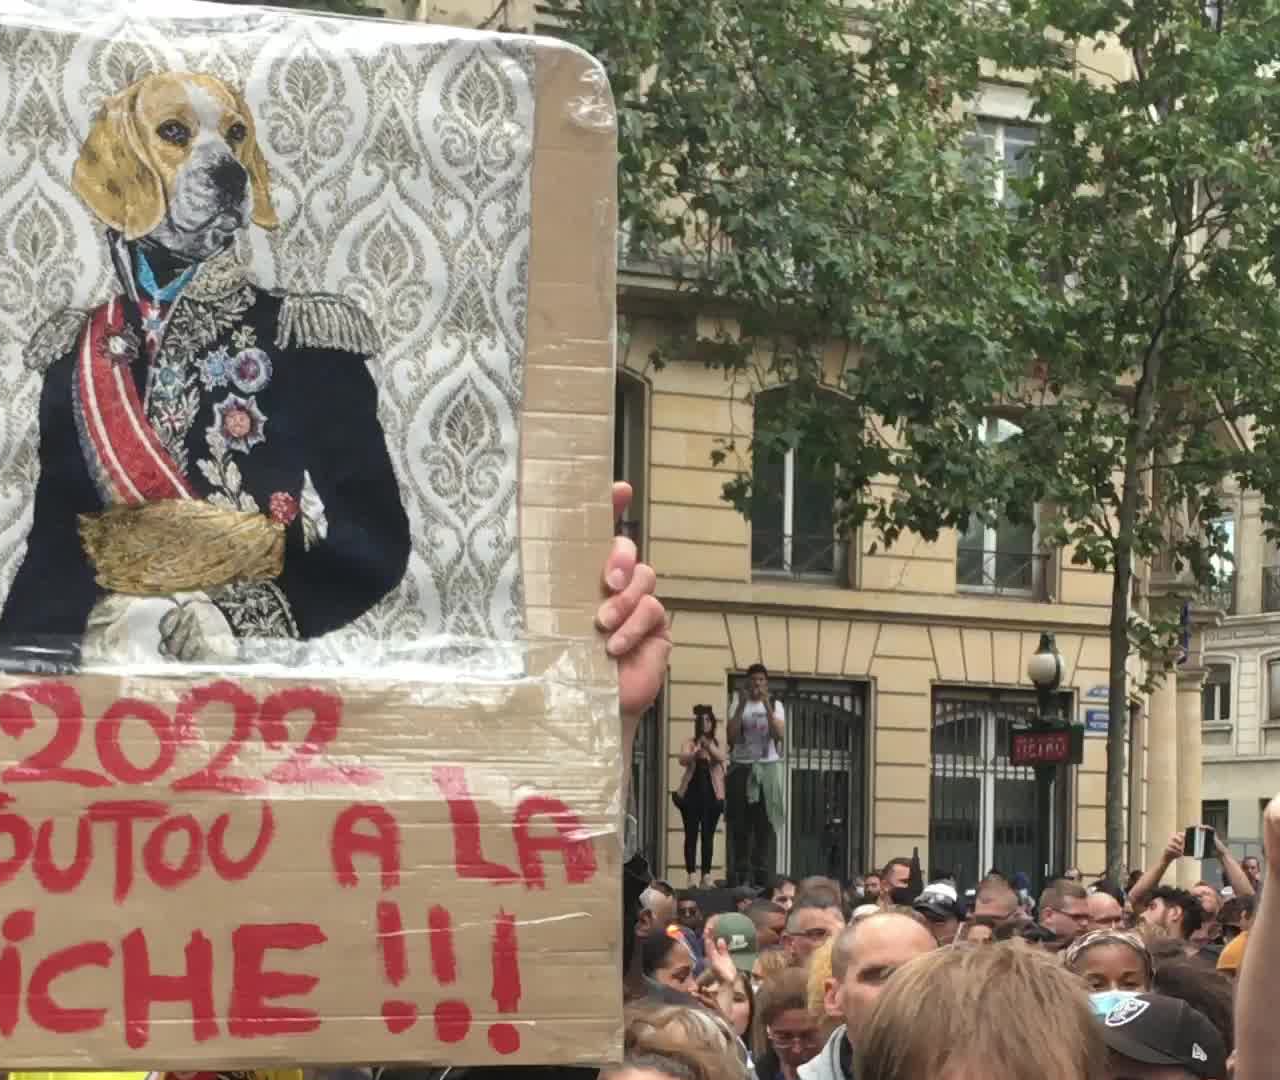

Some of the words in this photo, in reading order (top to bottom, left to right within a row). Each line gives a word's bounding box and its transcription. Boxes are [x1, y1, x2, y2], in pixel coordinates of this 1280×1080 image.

[330, 802, 403, 890] A
[429, 767, 597, 891] LA
[376, 900, 522, 1055] !!!
